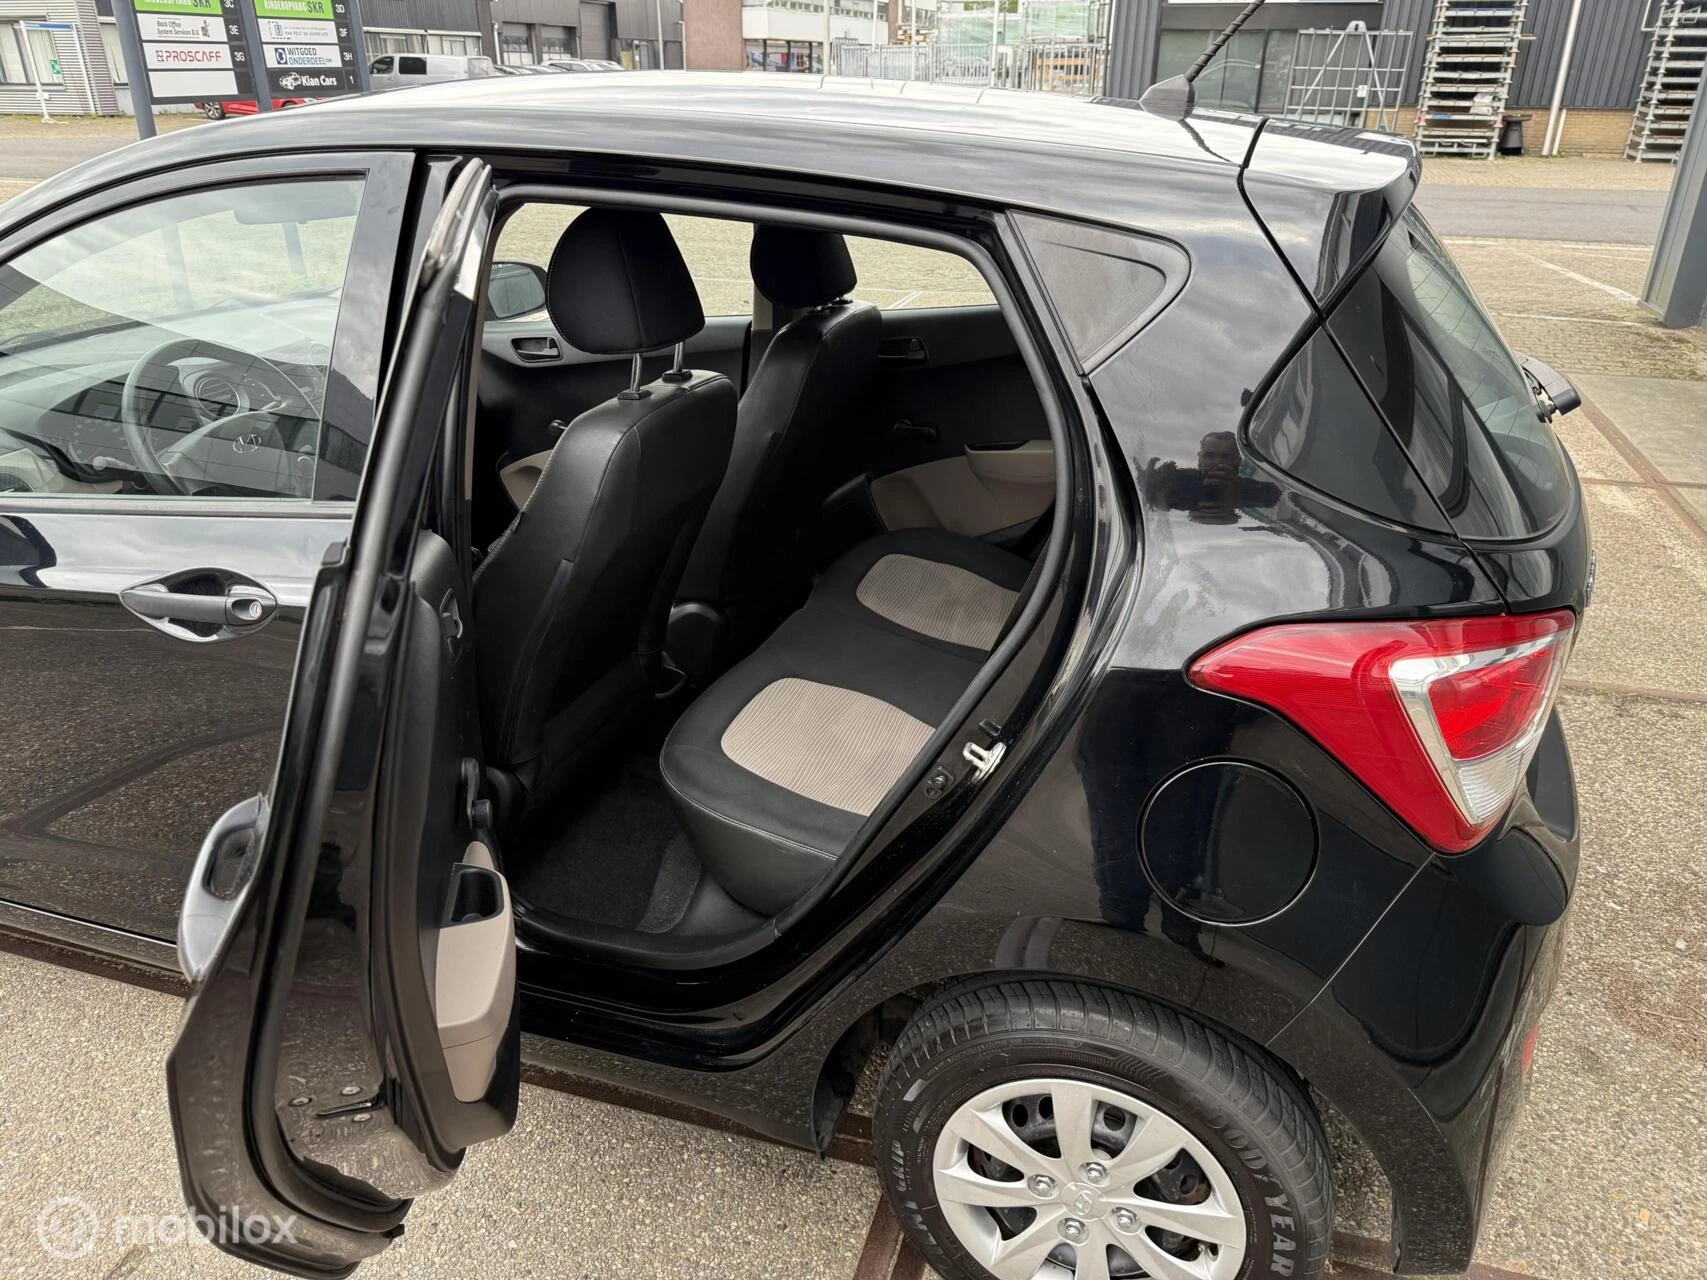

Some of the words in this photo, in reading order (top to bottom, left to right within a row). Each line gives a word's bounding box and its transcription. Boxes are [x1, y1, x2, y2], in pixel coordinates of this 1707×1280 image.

[307, 1, 324, 13] SKR
[335, 4, 345, 13] 3D
[229, 25, 239, 35] 3E
[339, 28, 348, 37] 3F
[165, 50, 221, 62] PROSCAFF
[287, 47, 317, 56] WITGOED
[343, 52, 353, 60] 3H
[234, 52, 245, 61] 3G
[301, 75, 320, 86] Kian
[320, 75, 337, 86] Cars
[349, 76, 354, 84] 1
